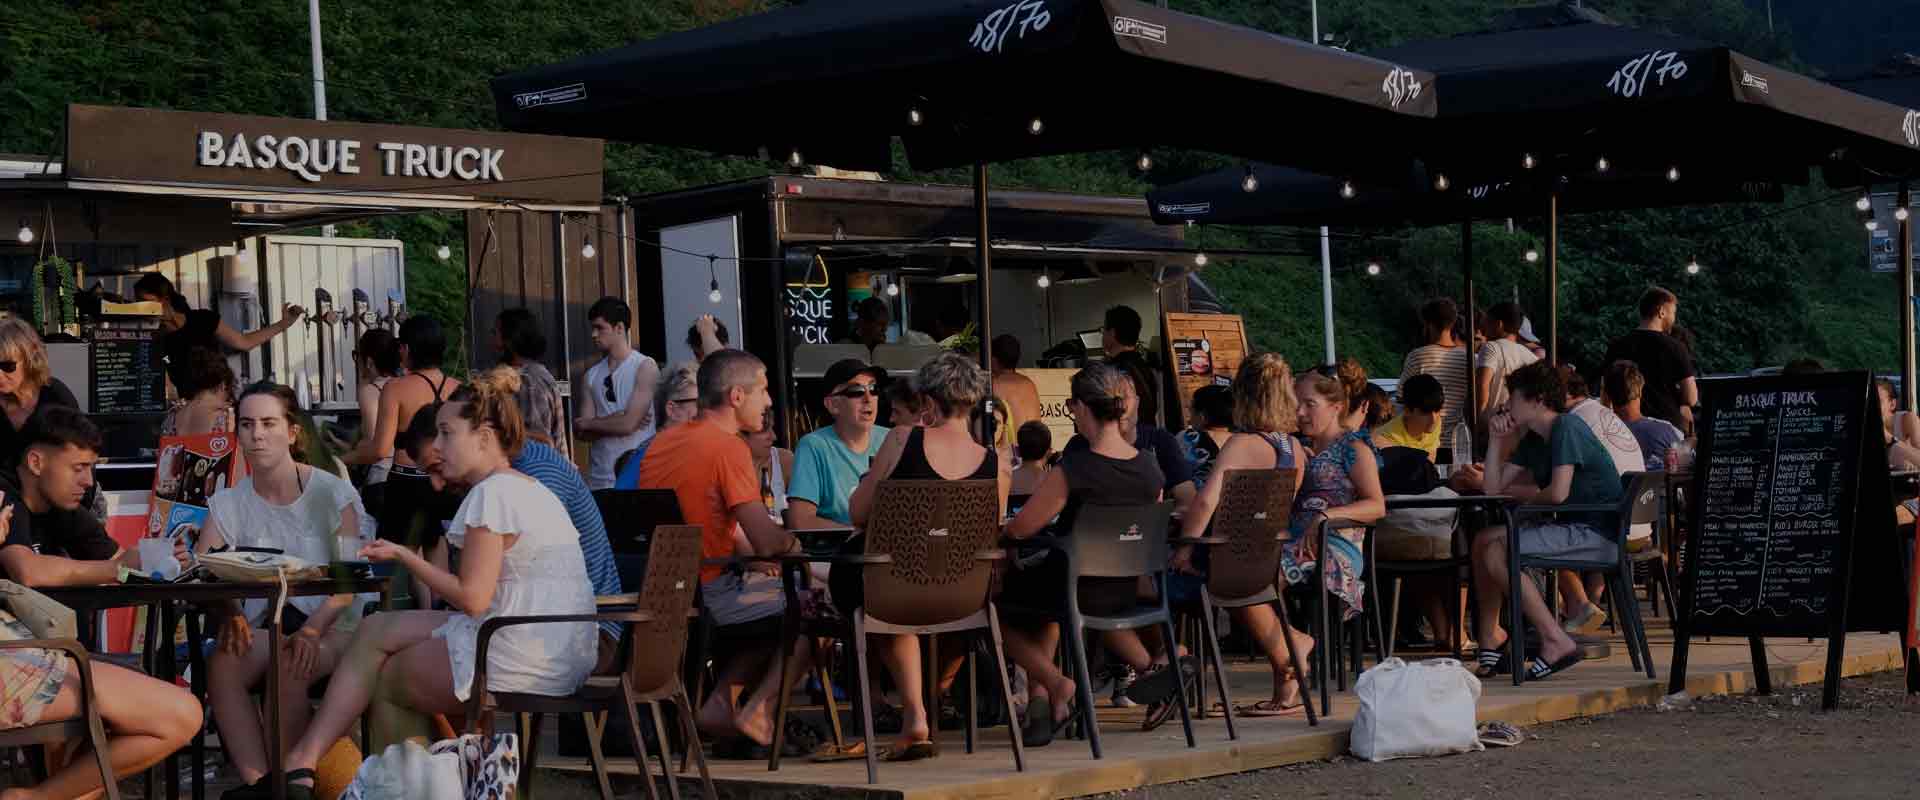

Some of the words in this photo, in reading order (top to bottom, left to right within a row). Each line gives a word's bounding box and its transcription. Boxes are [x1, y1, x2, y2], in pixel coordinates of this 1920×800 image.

[968, 0, 1051, 54] 18/70
[1606, 49, 1688, 98] 18/70
[199, 131, 361, 182] BASQUE
[377, 142, 505, 181] TRUCK
[1735, 393, 1777, 408] BASQUE
[1781, 391, 1816, 405] TRUCK
